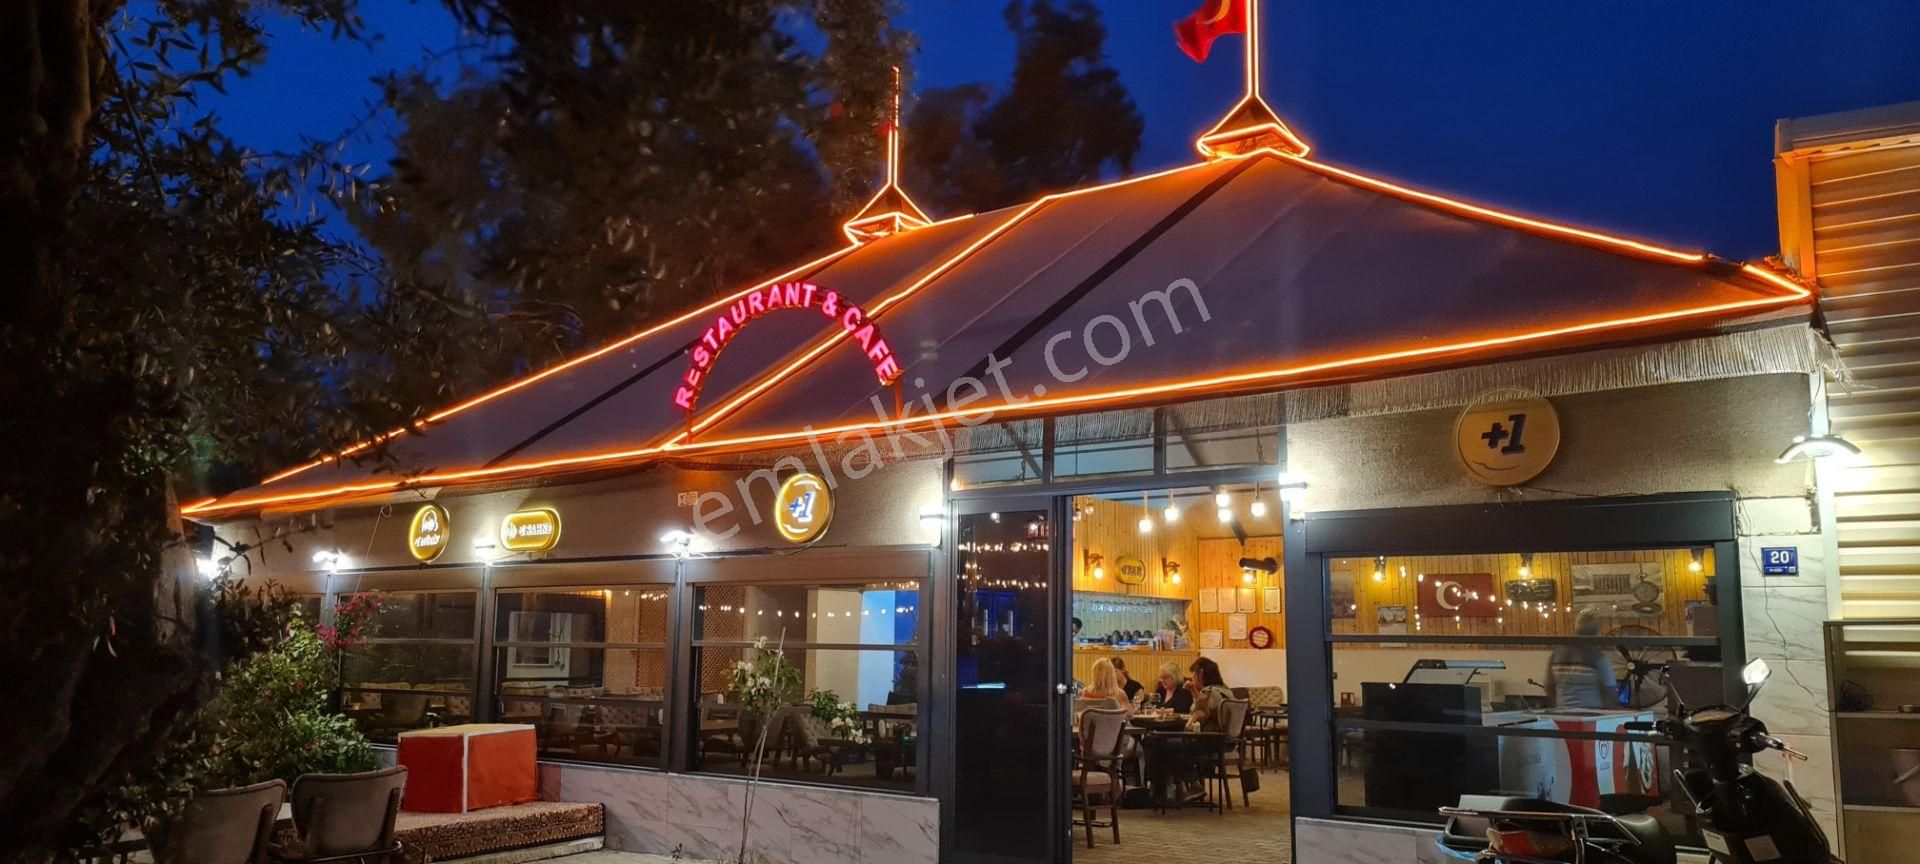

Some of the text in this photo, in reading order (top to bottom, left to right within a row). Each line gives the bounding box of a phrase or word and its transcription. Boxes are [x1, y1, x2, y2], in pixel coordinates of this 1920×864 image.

[675, 282, 899, 410] RESTAURANT & CAFE
[1481, 413, 1527, 456] +1
[788, 490, 816, 522] +1
[1770, 550, 1790, 564] 20
